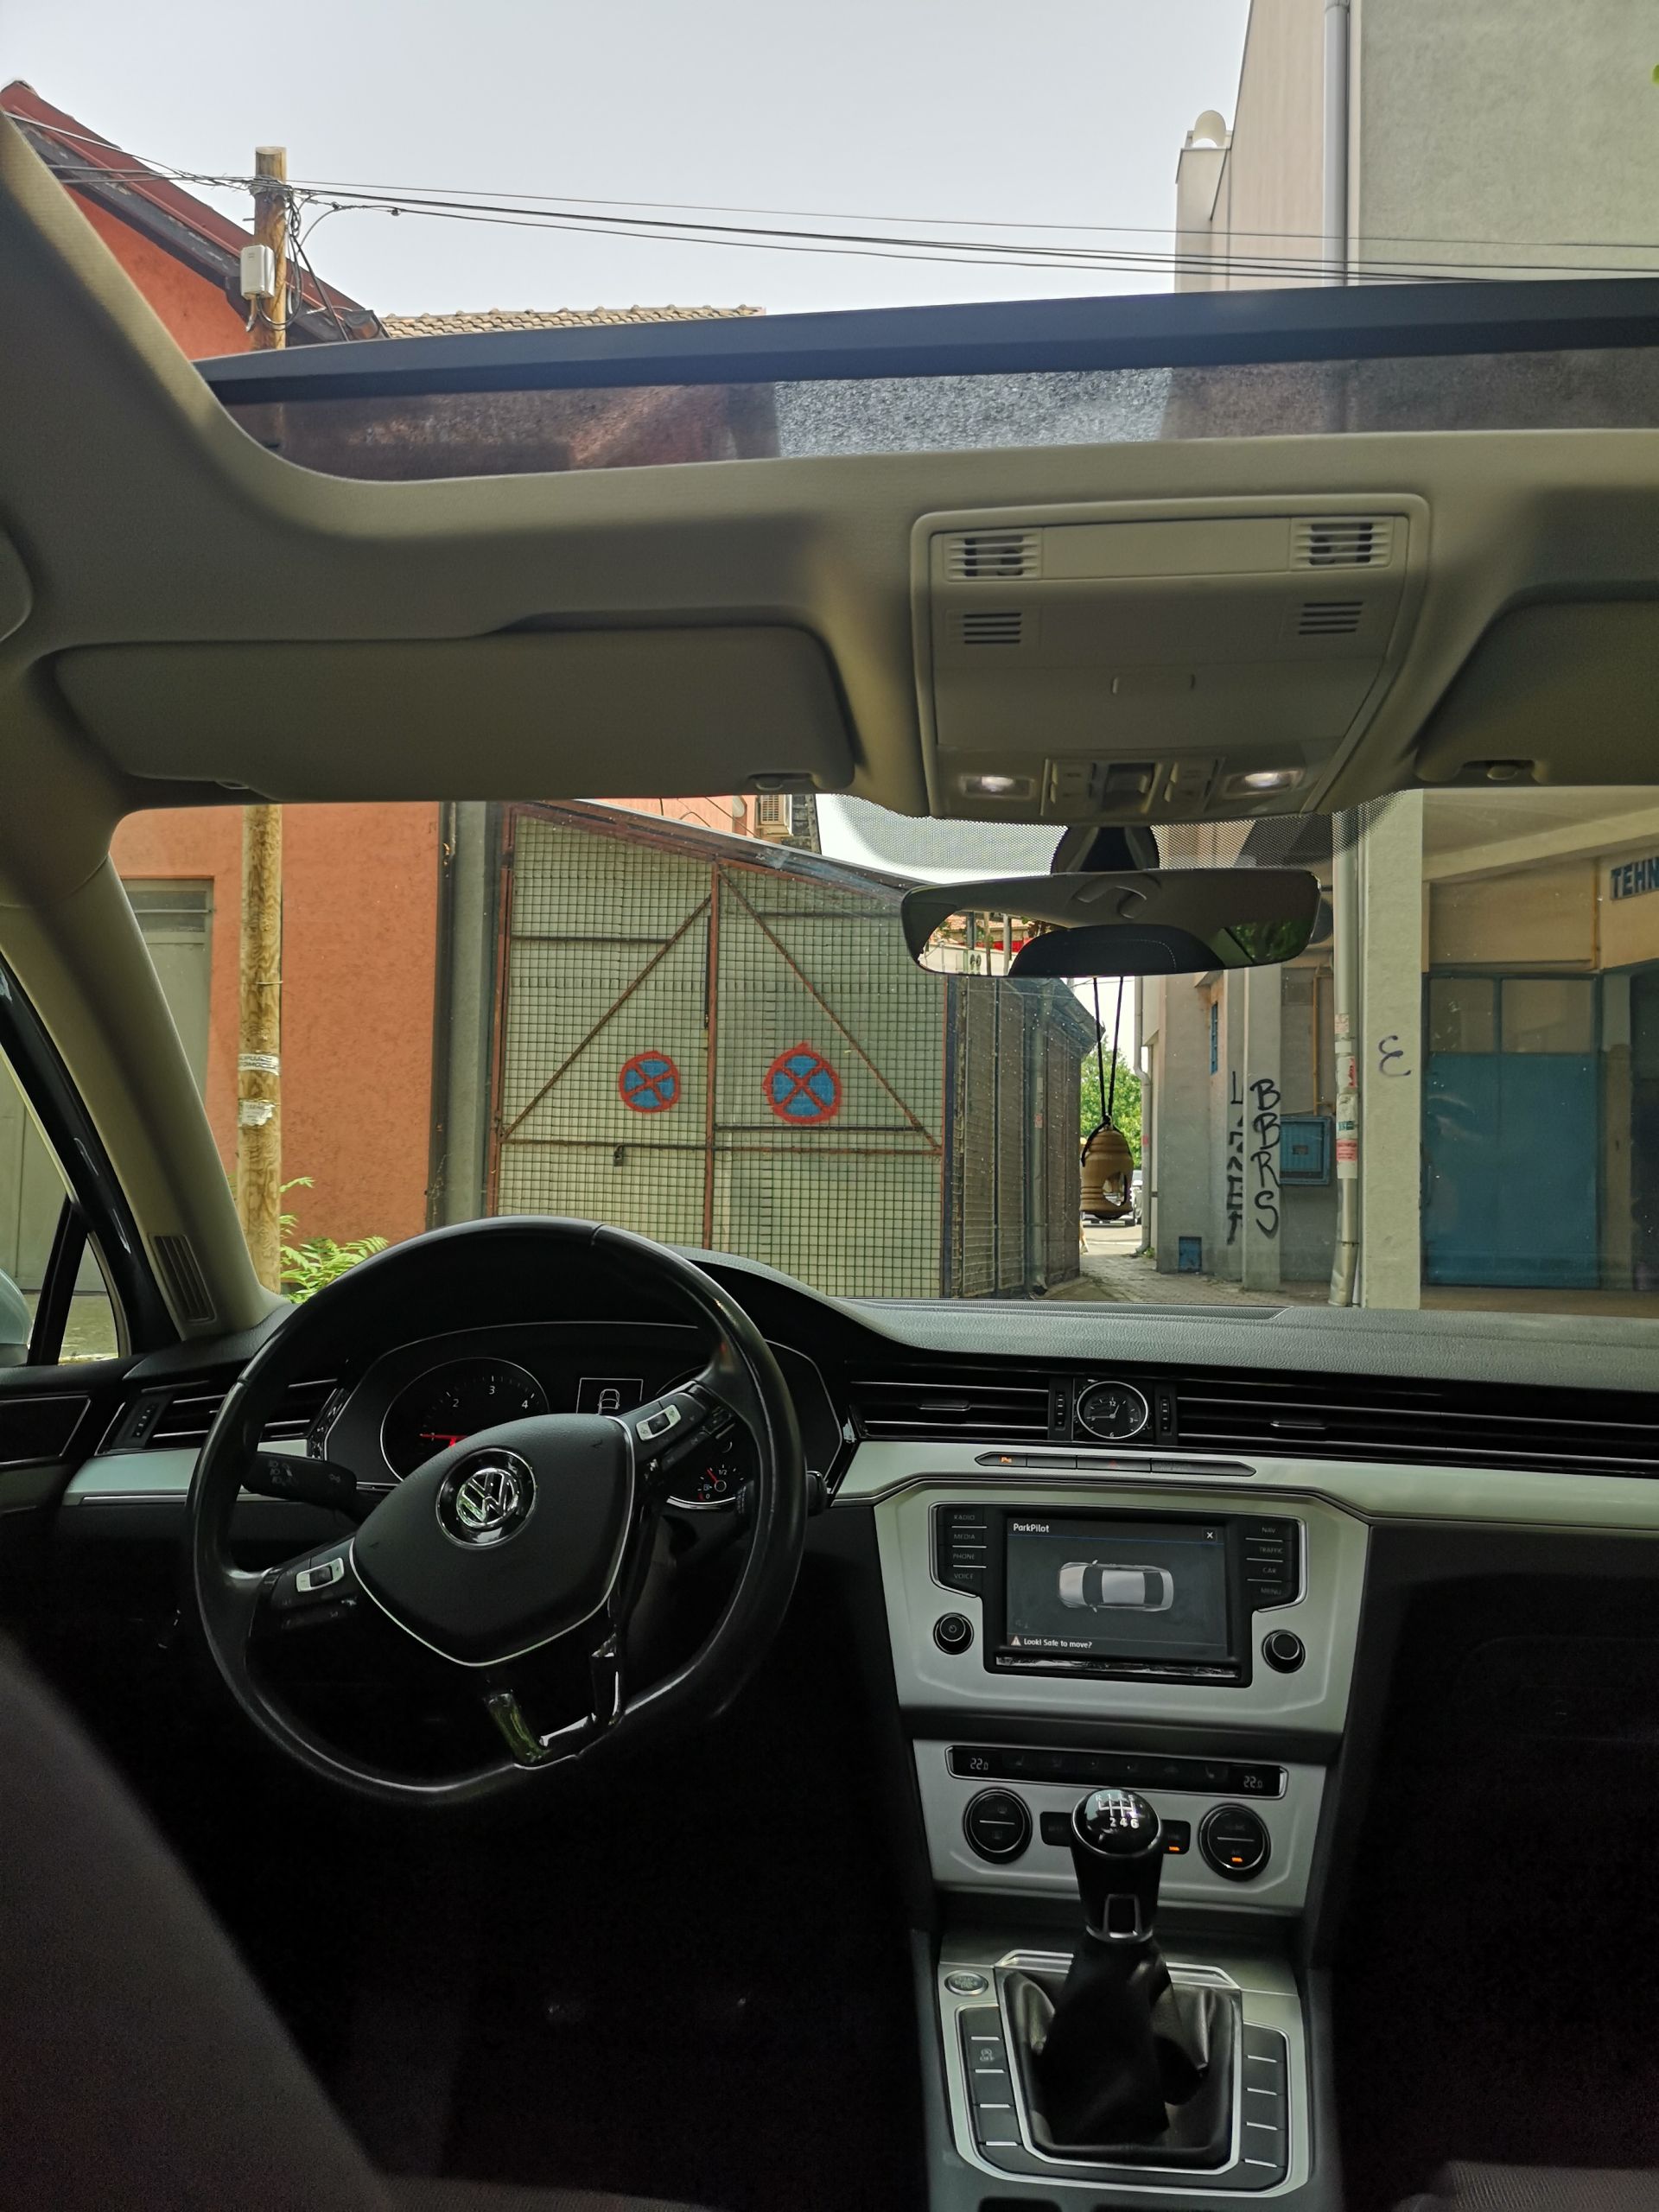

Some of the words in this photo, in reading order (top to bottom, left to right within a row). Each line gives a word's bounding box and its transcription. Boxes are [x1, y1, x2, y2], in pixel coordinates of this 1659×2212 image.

[1611, 856, 1659, 899] TEHN
[489, 1385, 496, 1395] 3
[452, 1398, 460, 1408] 2
[521, 1399, 529, 1409] 4
[1013, 1522, 1050, 1533] ParkPilot
[1023, 1637, 1042, 1646] Look!
[1043, 1638, 1059, 1647] Safe
[1109, 1817, 1117, 1827] 2
[1120, 1817, 1128, 1827] 4
[1130, 1818, 1140, 1829] 6
